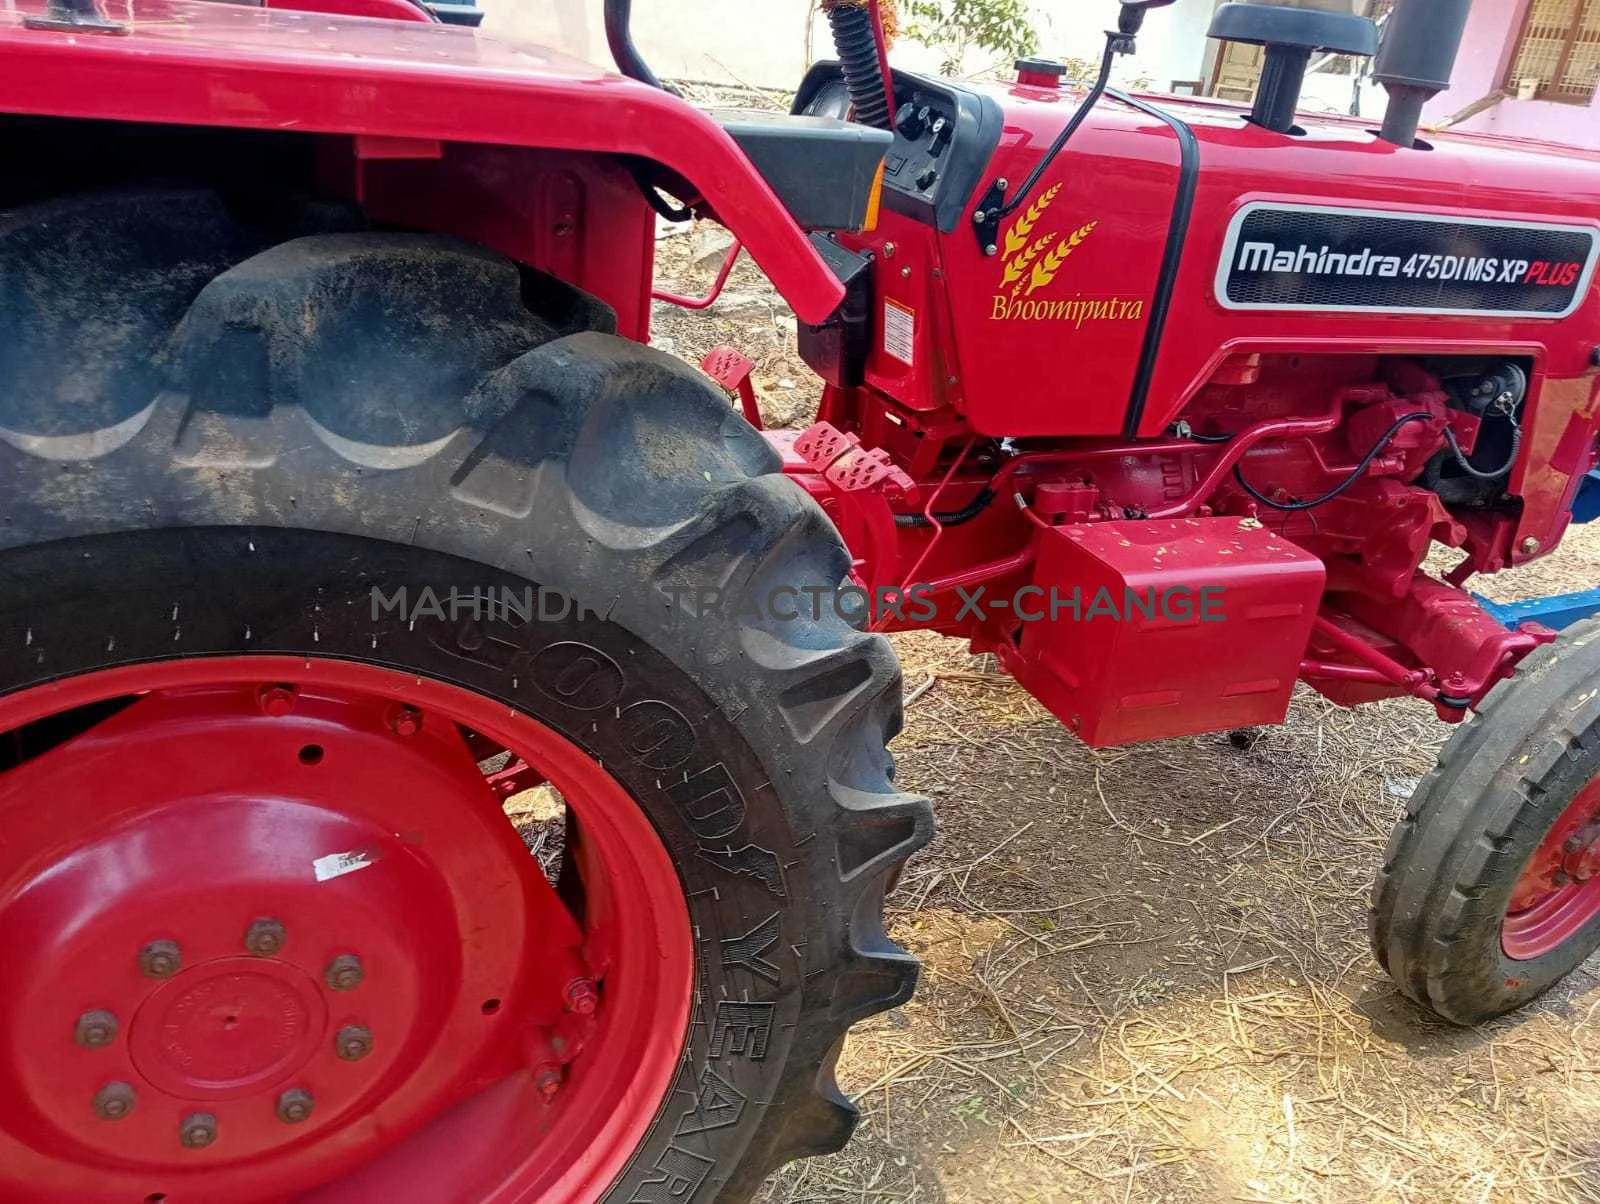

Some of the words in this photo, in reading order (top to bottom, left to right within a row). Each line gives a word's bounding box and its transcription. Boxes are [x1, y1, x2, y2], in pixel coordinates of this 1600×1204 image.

[1238, 241, 1400, 277] Mahindra
[1464, 257, 1498, 282] MS
[1524, 261, 1582, 286] PLUS
[989, 292, 1143, 330] Bhoomiputra
